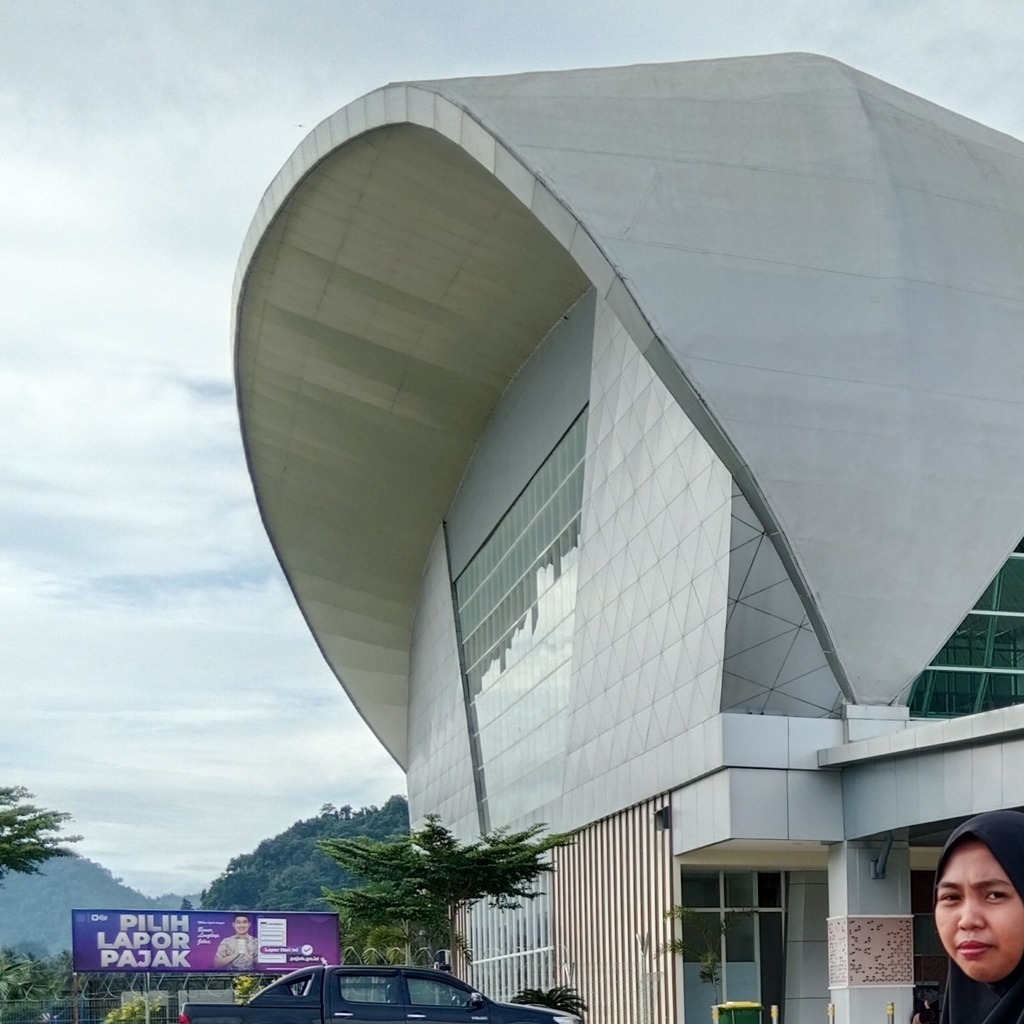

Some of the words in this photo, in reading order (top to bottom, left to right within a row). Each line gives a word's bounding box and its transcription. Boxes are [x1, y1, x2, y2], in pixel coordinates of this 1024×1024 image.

[119, 914, 190, 932] PILIH
[97, 931, 191, 950] LAPOR
[101, 949, 192, 968] PAJAK
